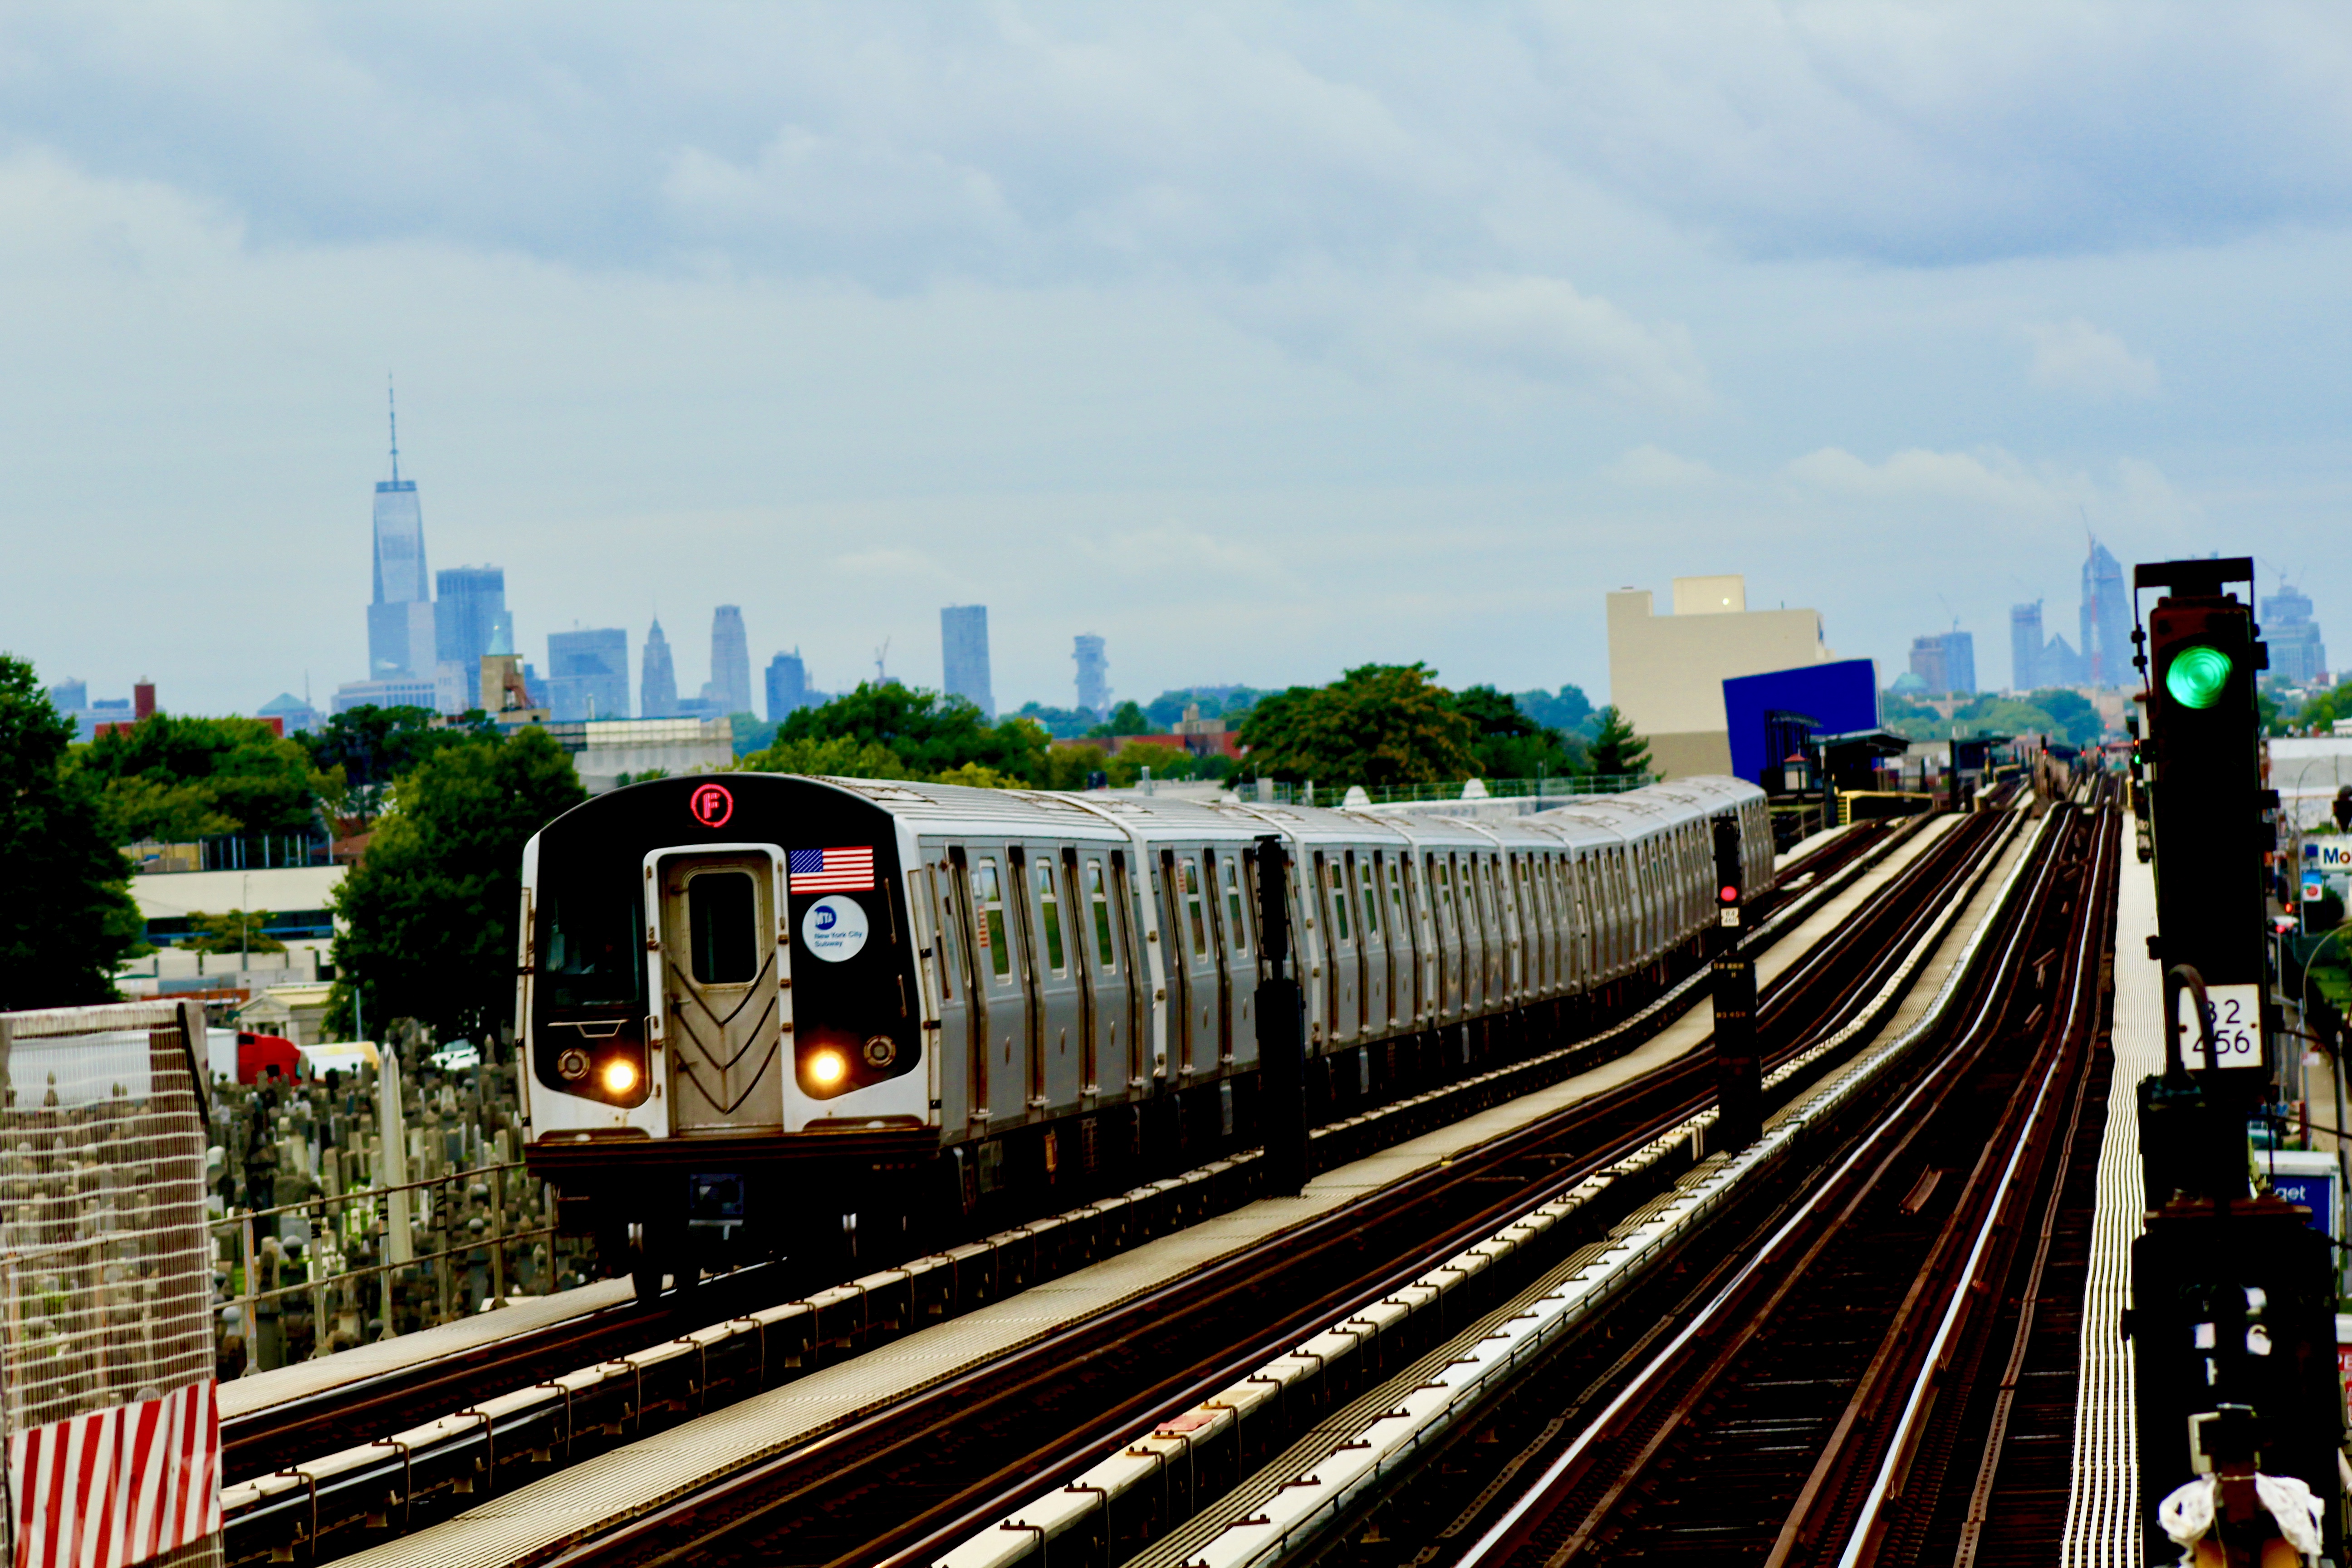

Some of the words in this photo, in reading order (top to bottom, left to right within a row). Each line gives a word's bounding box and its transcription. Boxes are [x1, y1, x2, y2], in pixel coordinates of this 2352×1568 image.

[703, 793, 720, 818] F
[2323, 847, 2352, 864] Mo
[815, 911, 833, 926] MTA
